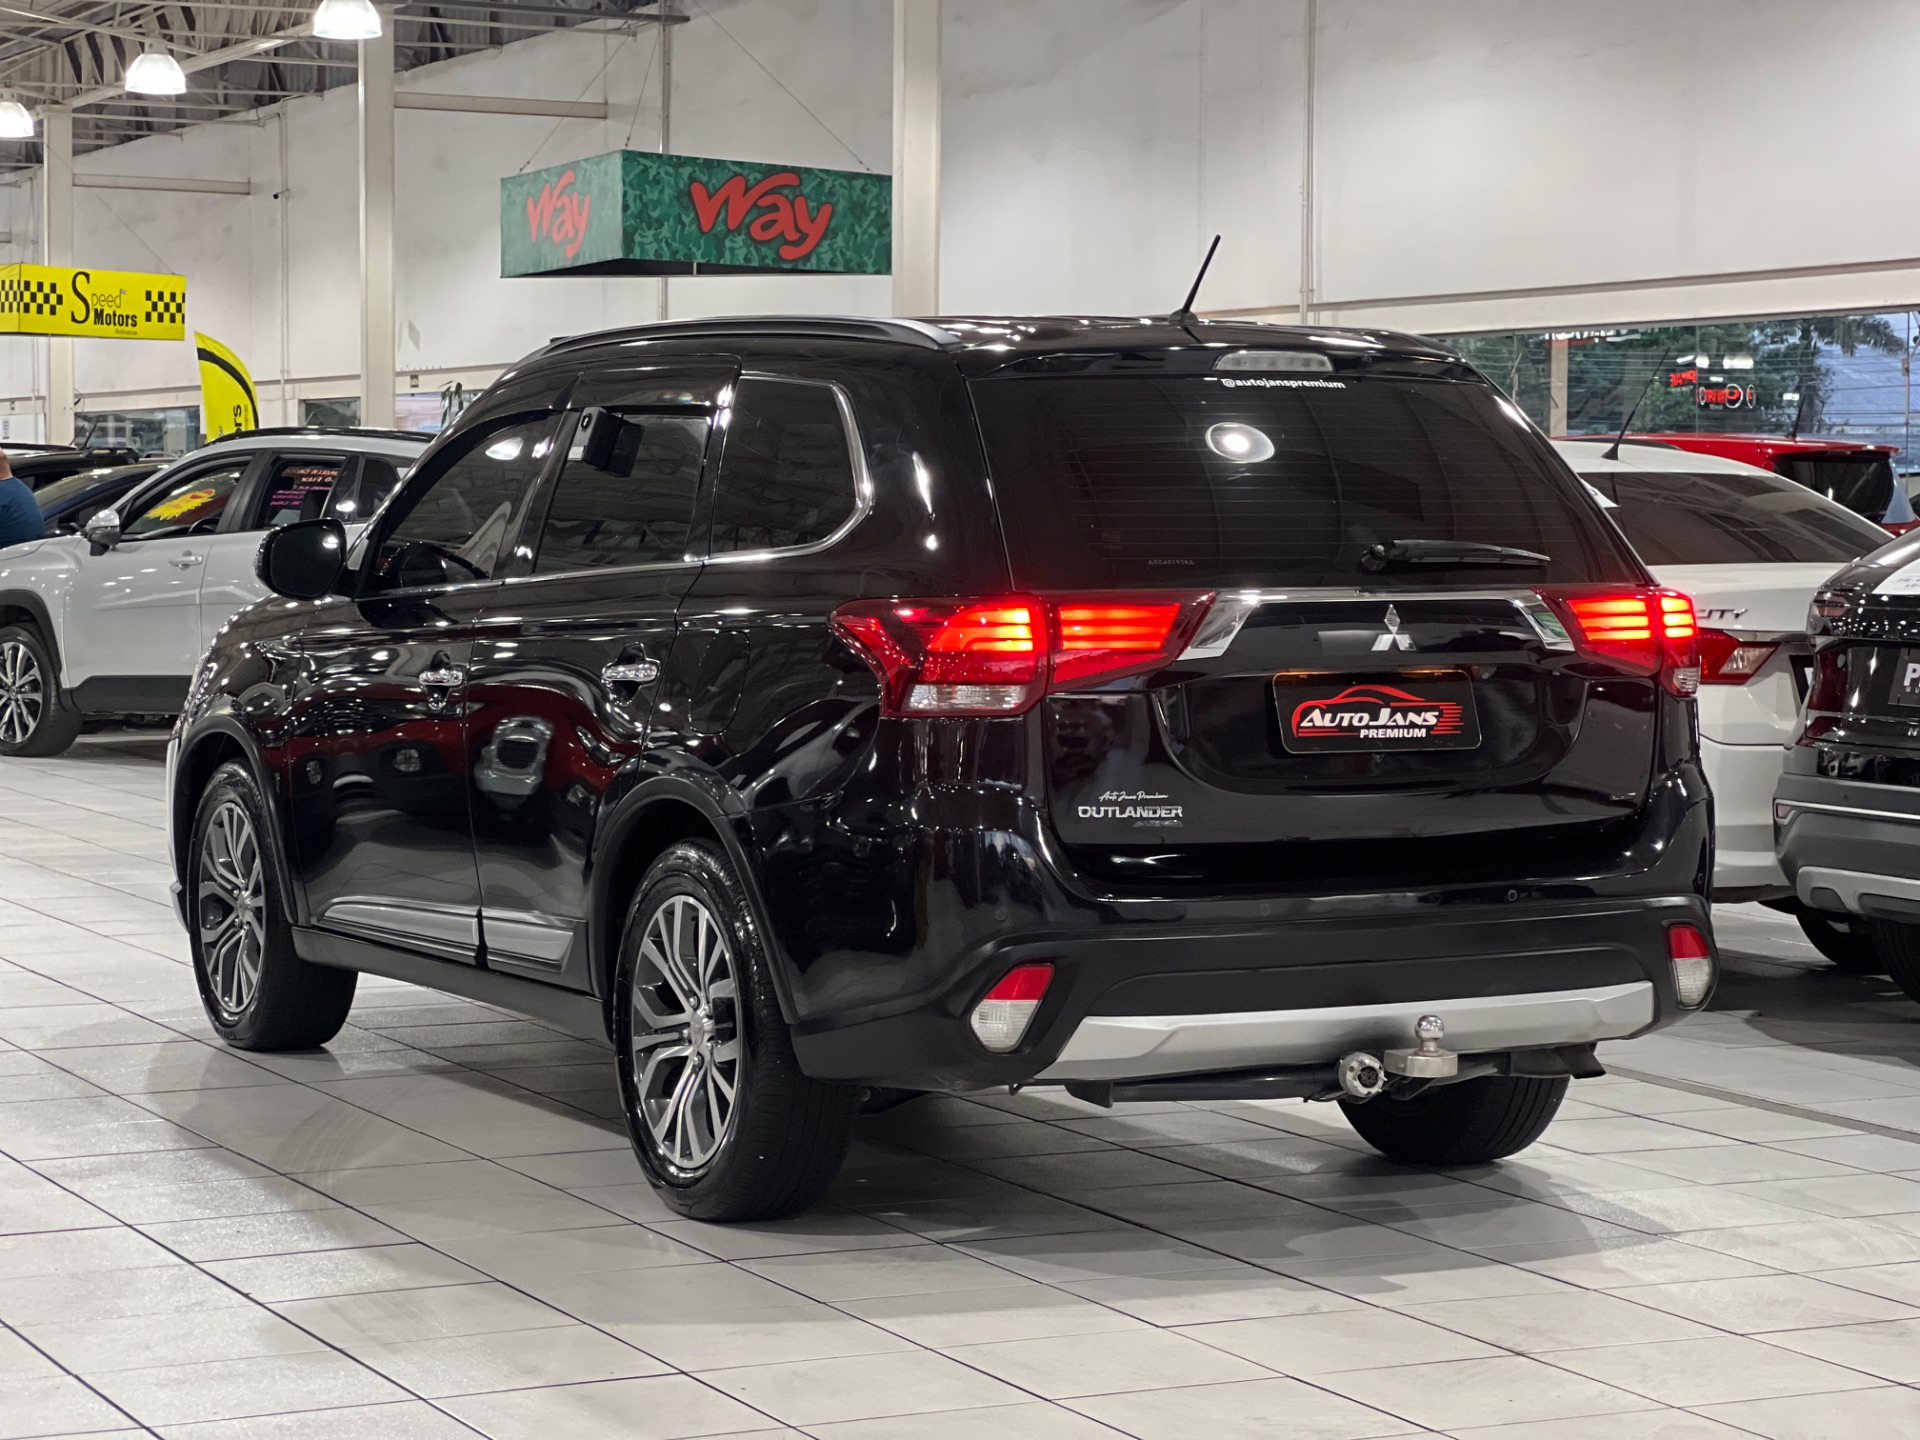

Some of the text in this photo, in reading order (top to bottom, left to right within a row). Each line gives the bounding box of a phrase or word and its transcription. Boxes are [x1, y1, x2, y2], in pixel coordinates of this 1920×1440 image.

[71, 271, 123, 325] Speed
[93, 307, 138, 328] Motors
[1221, 378, 1346, 389] @autojanspremium
[1359, 728, 1426, 739] PREMIUM
[1078, 806, 1183, 818] OUTLANDER
